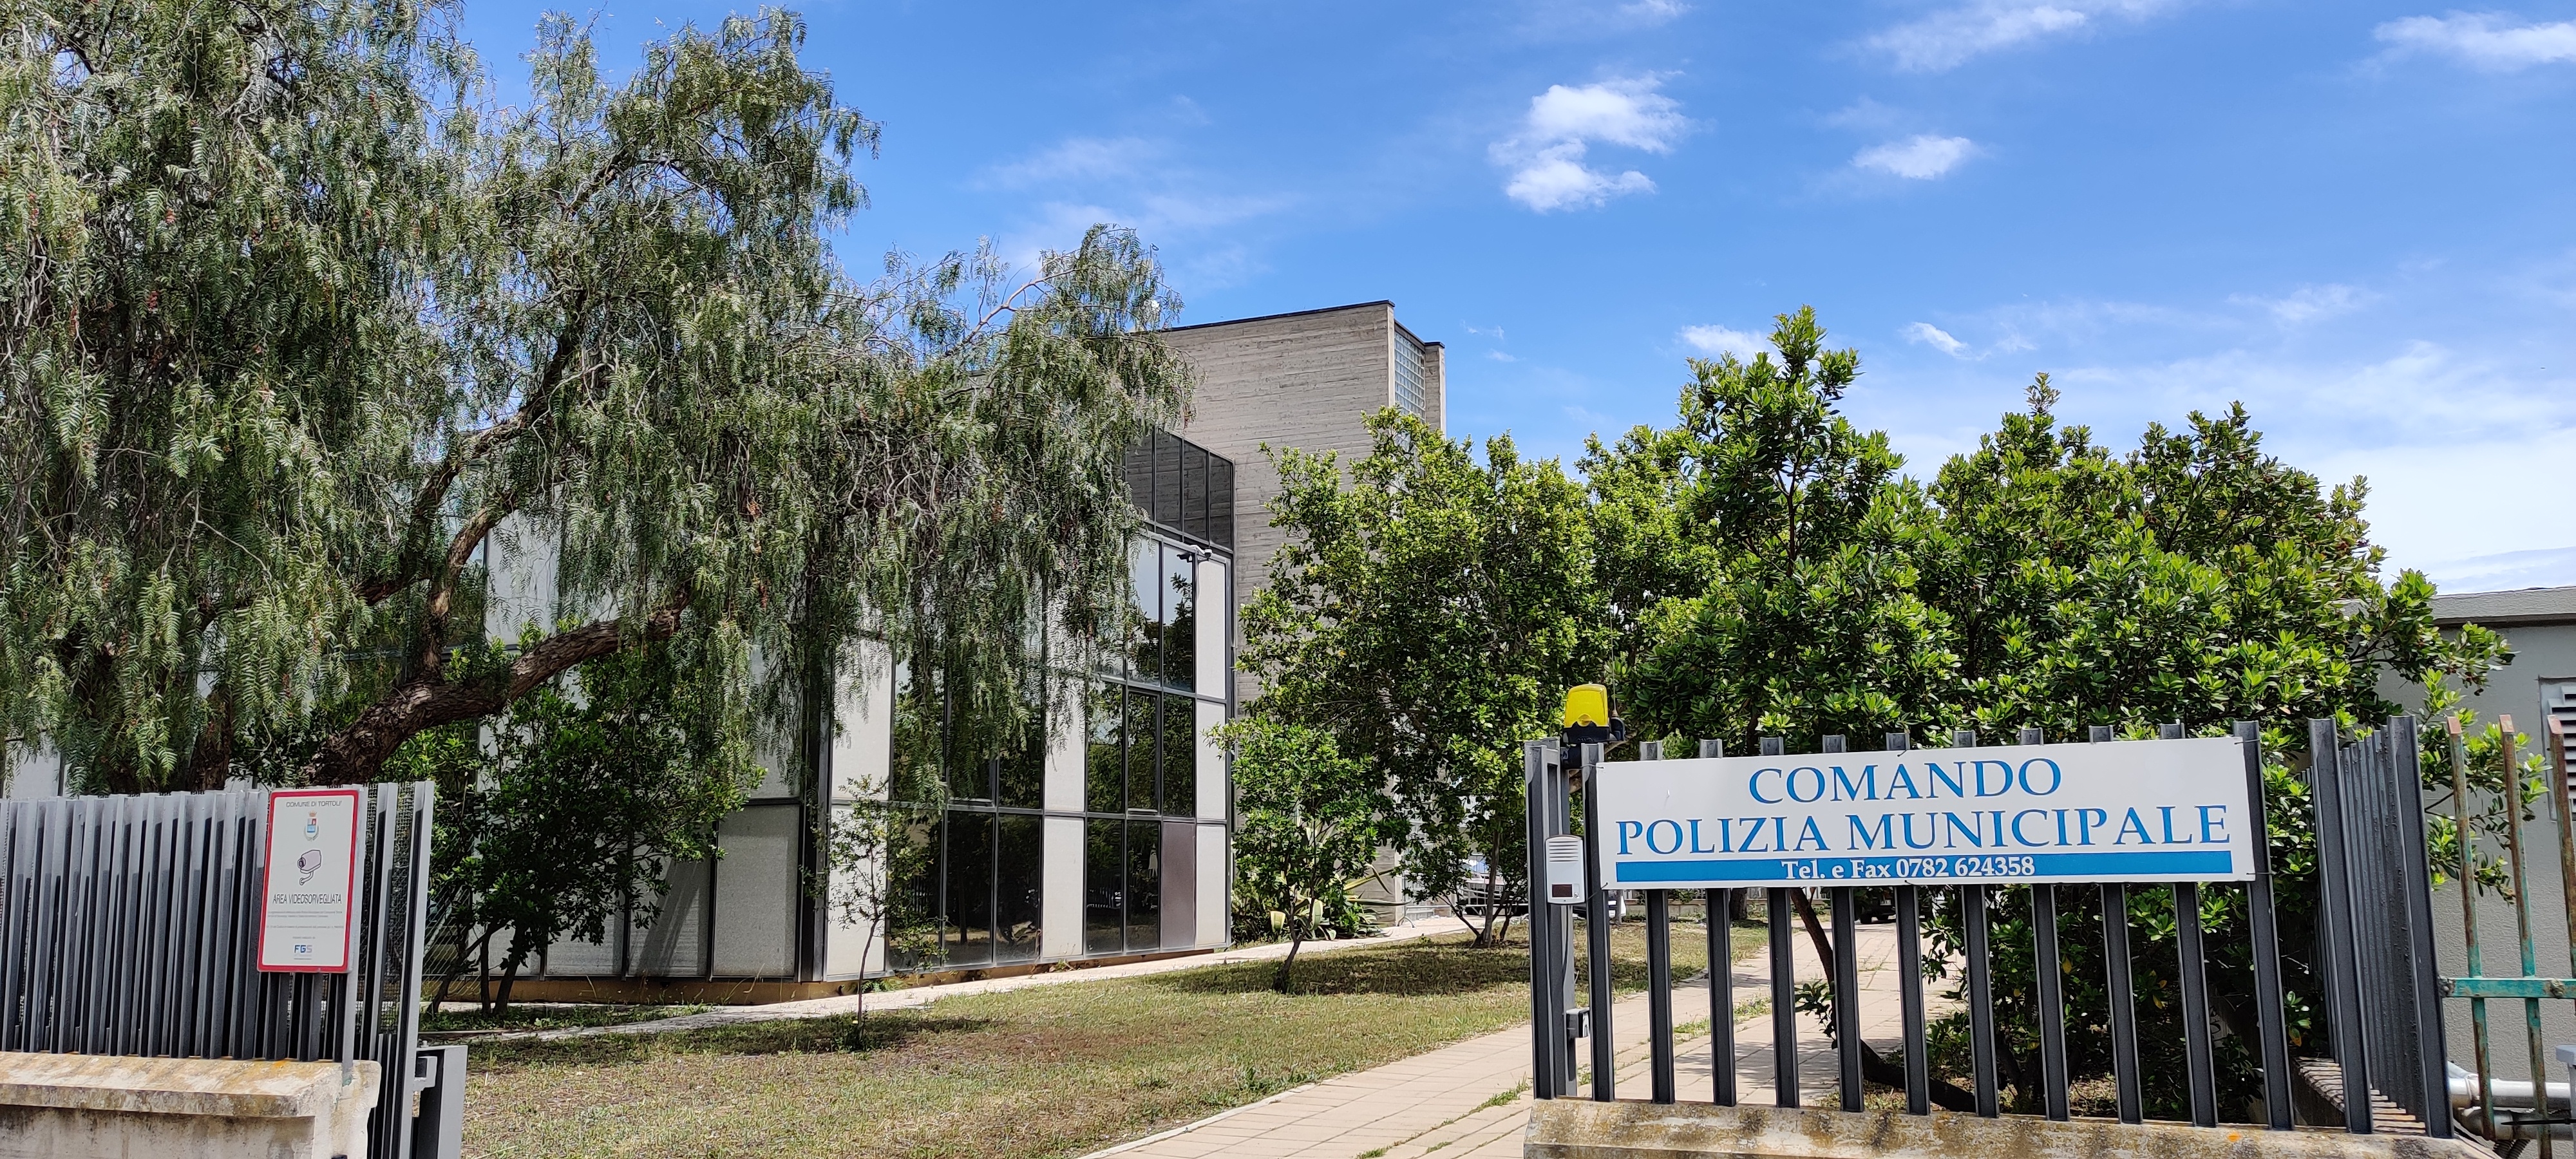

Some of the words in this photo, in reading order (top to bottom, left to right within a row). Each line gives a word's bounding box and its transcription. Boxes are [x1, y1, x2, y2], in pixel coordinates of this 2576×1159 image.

[1748, 758, 2062, 805] COMANDO
[1616, 815, 1830, 856] POLIZIA
[1846, 804, 2230, 852] MUNICIPALE
[1781, 860, 1826, 880] Tel.
[1831, 864, 1845, 878] e
[1850, 859, 1892, 878] Fax
[1895, 858, 1949, 878] 0782
[1954, 856, 2035, 876] 624358
[272, 894, 287, 904] AREA
[289, 894, 342, 904] VIDEOSORVEGLIATA
[294, 945, 312, 953] FGS
